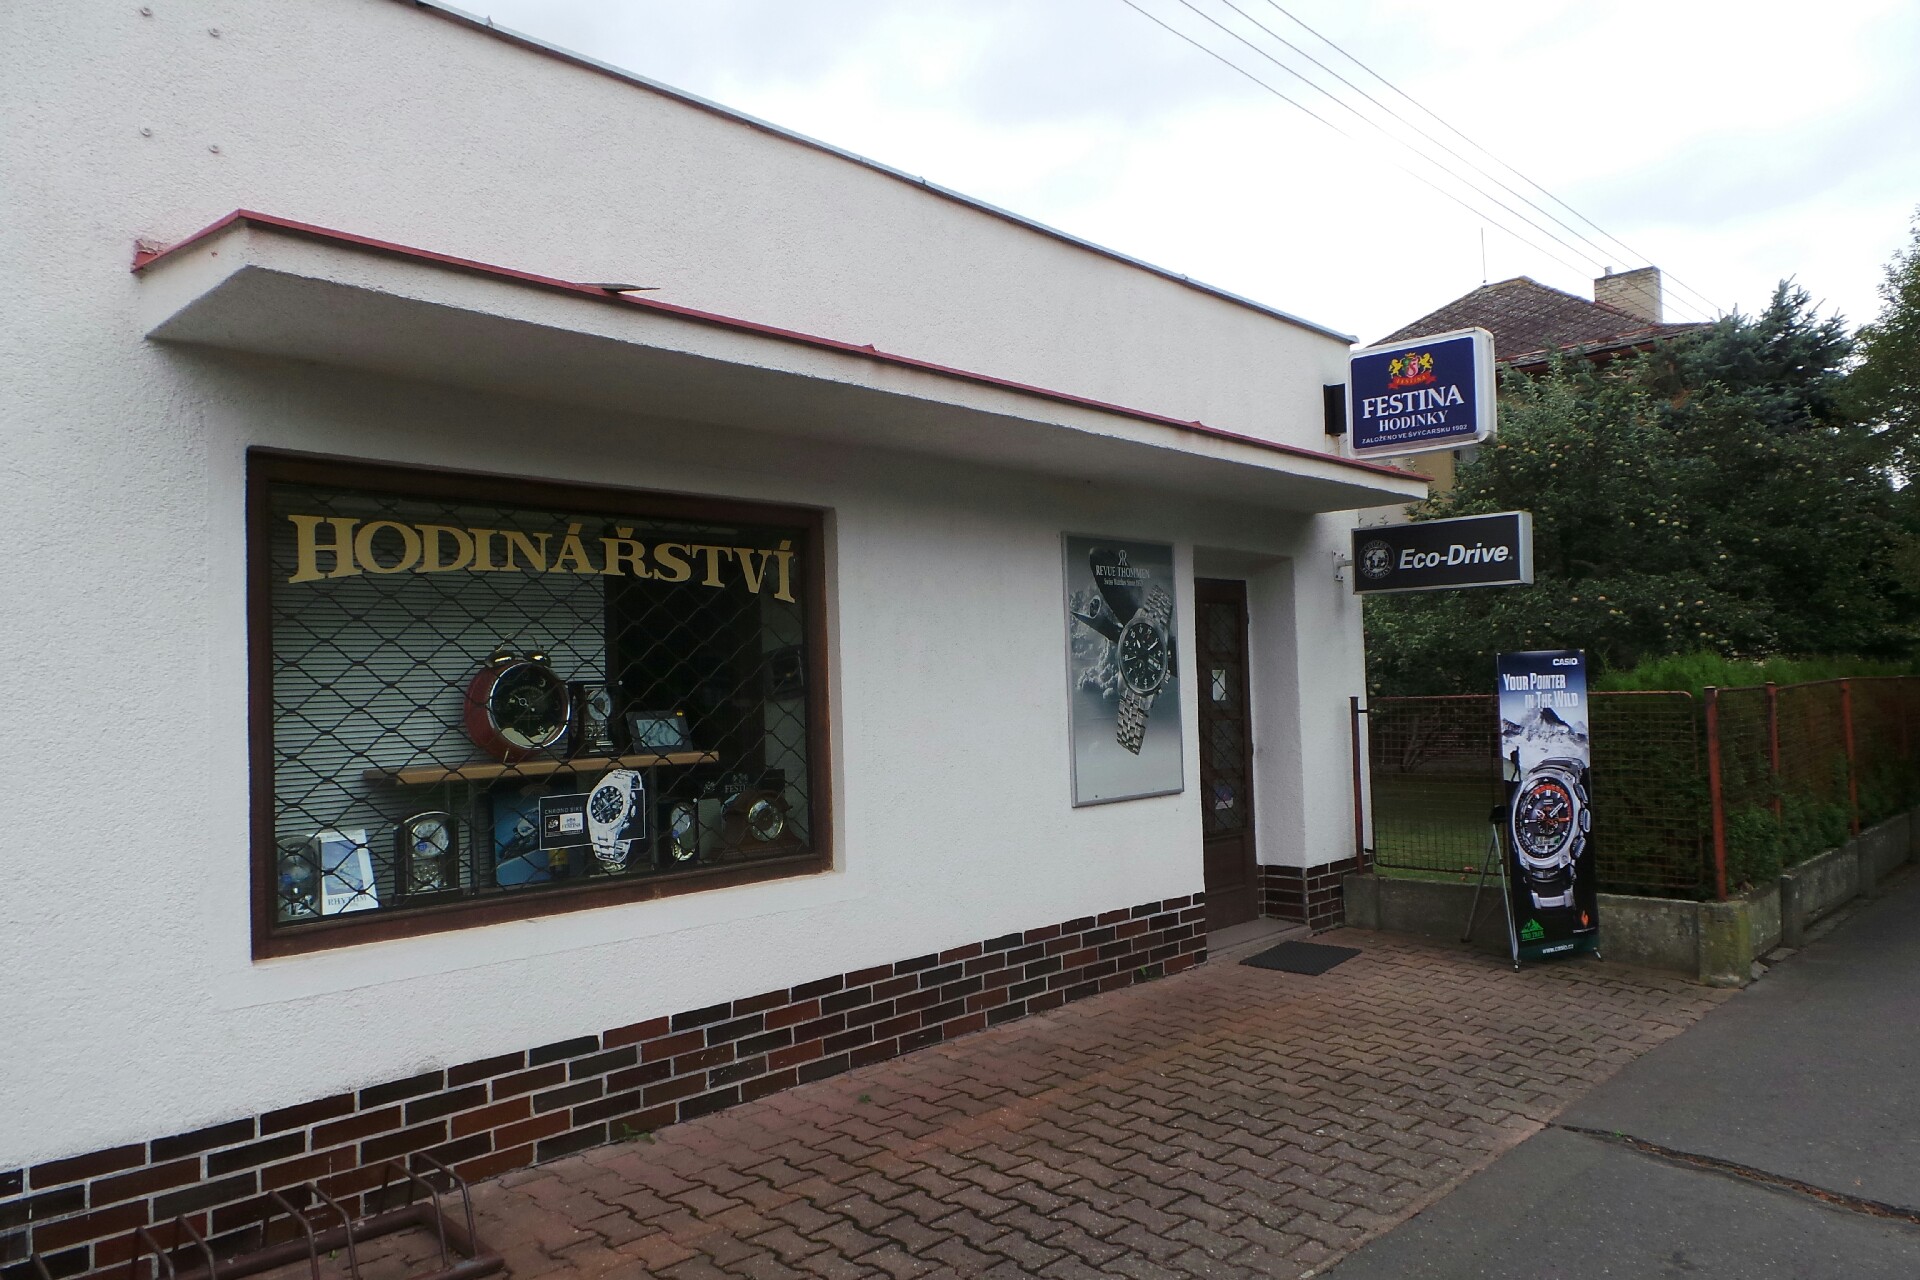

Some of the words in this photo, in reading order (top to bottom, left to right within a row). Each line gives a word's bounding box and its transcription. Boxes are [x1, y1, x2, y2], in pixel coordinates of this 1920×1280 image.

[1363, 385, 1464, 418] FESTINA
[1380, 410, 1448, 431] HODINKY
[1361, 434, 1397, 444] ZALOŽENO
[287, 514, 796, 603] HODINÁŘSTVÍ
[1399, 543, 1510, 570] Eco-Drive
[1096, 565, 1115, 577] REVUE
[1117, 567, 1150, 578] THOMMEN
[1552, 658, 1578, 666] CASIO
[1503, 673, 1529, 691] YOUR
[1530, 672, 1566, 690] POINTER
[1525, 694, 1534, 708] IN
[1535, 691, 1552, 708] THE
[1554, 690, 1578, 708] WILD
